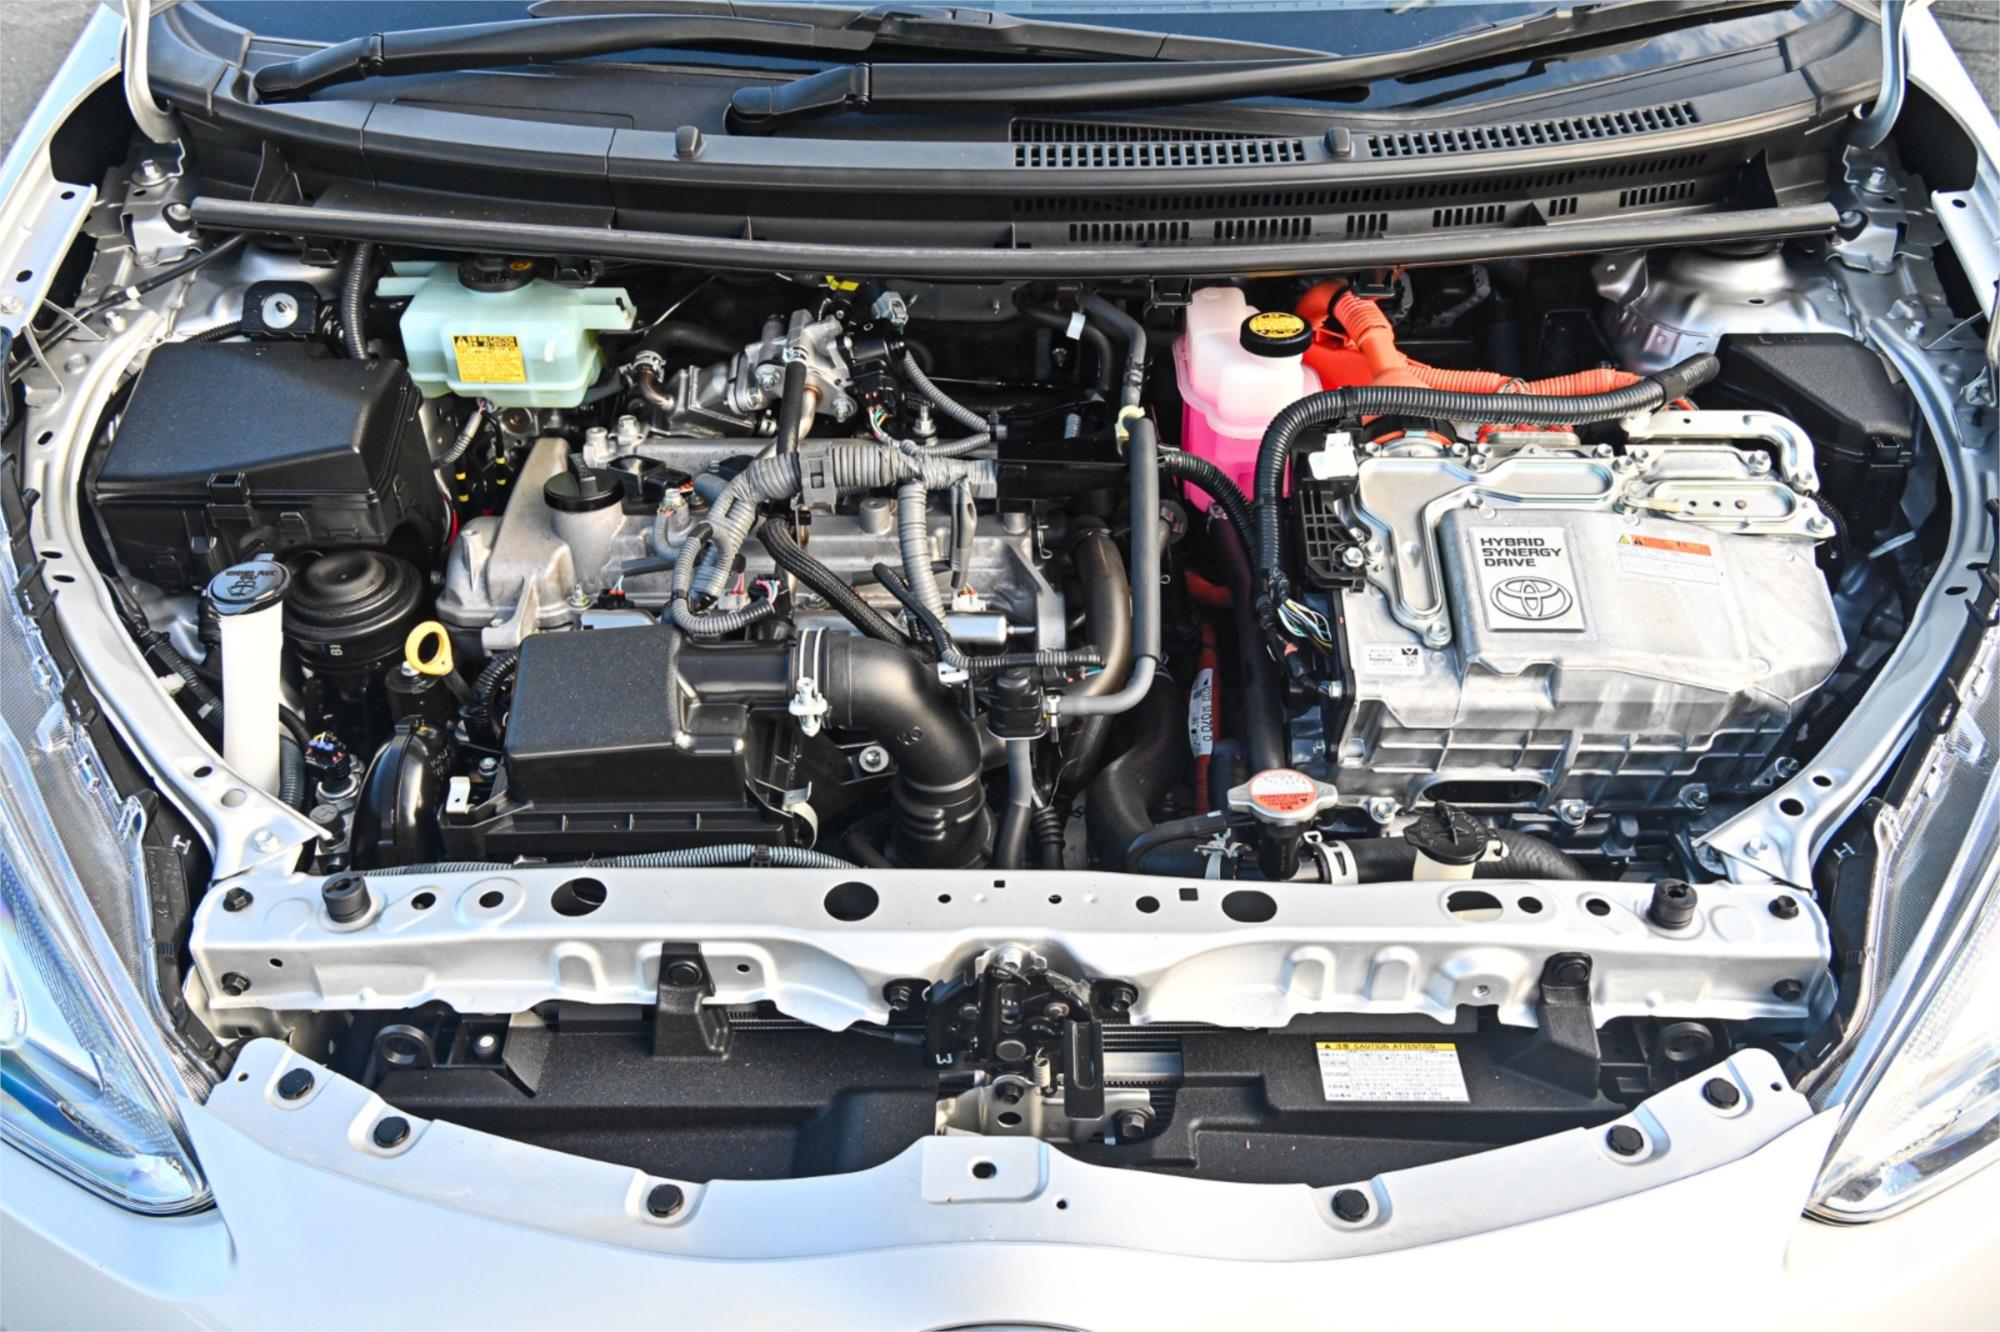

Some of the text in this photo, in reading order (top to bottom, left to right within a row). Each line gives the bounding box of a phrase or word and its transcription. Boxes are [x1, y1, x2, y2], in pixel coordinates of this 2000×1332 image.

[1480, 538, 1545, 546] HYBRID
[1482, 548, 1562, 557] SYNERGY
[1484, 558, 1536, 567] DRIVE
[1833, 842, 1856, 859] H
